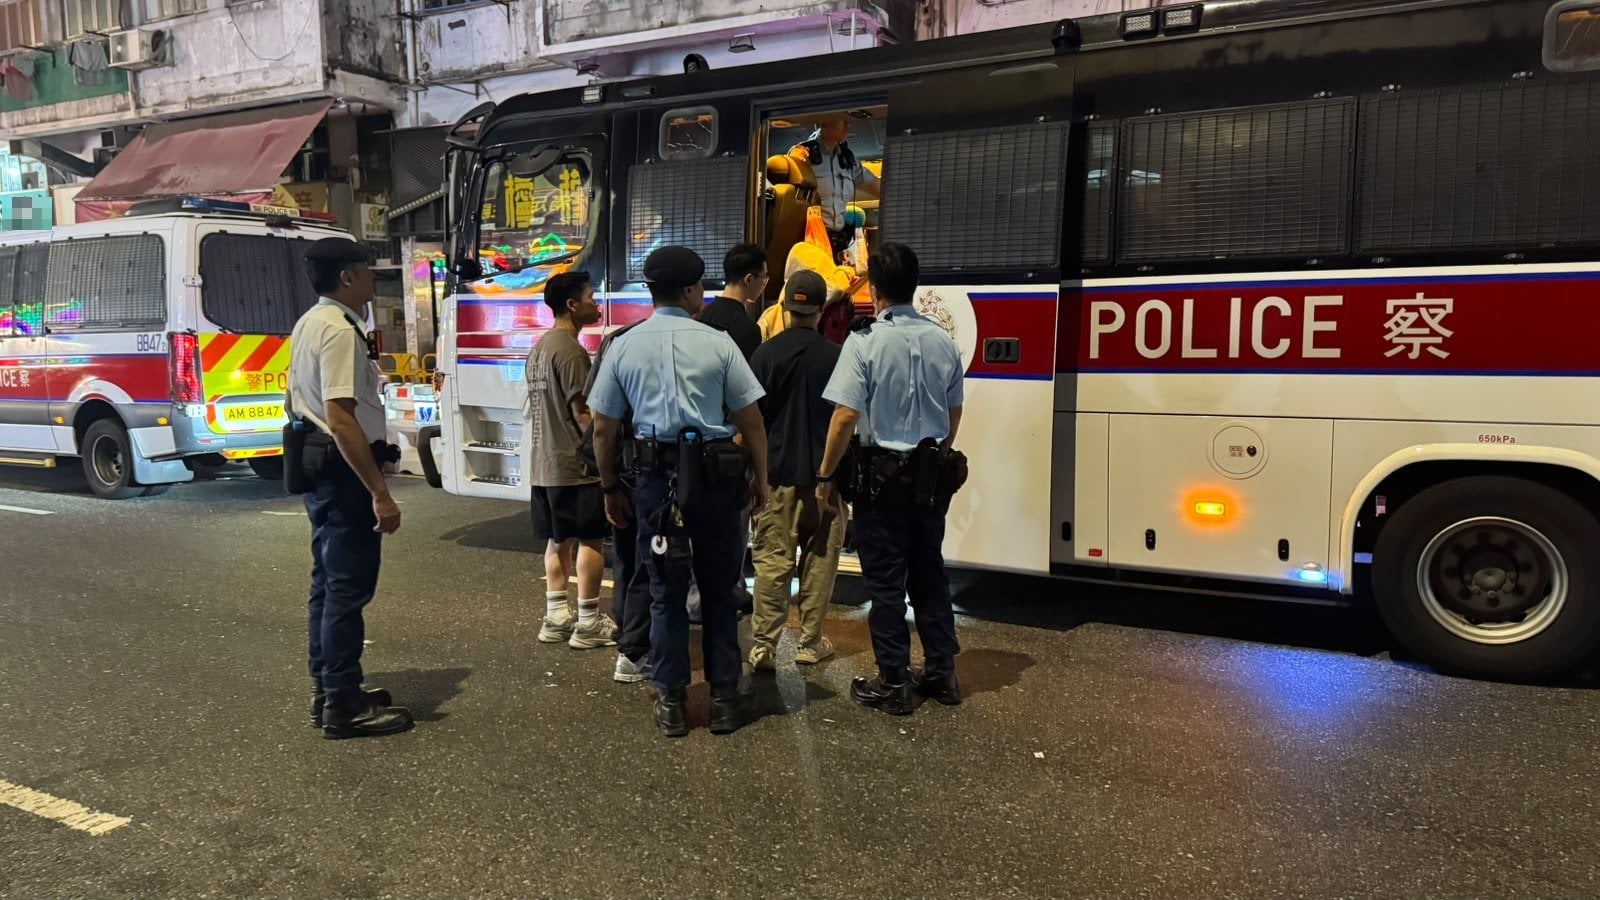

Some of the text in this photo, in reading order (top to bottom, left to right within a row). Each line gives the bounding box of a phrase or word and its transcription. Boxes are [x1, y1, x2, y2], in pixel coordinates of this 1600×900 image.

[264, 206, 289, 215] POLICE
[1089, 292, 1455, 360] POLICE 察
[137, 334, 162, 351] 8847
[228, 405, 280, 419] AM 8847
[1478, 434, 1516, 444] 650kPa
